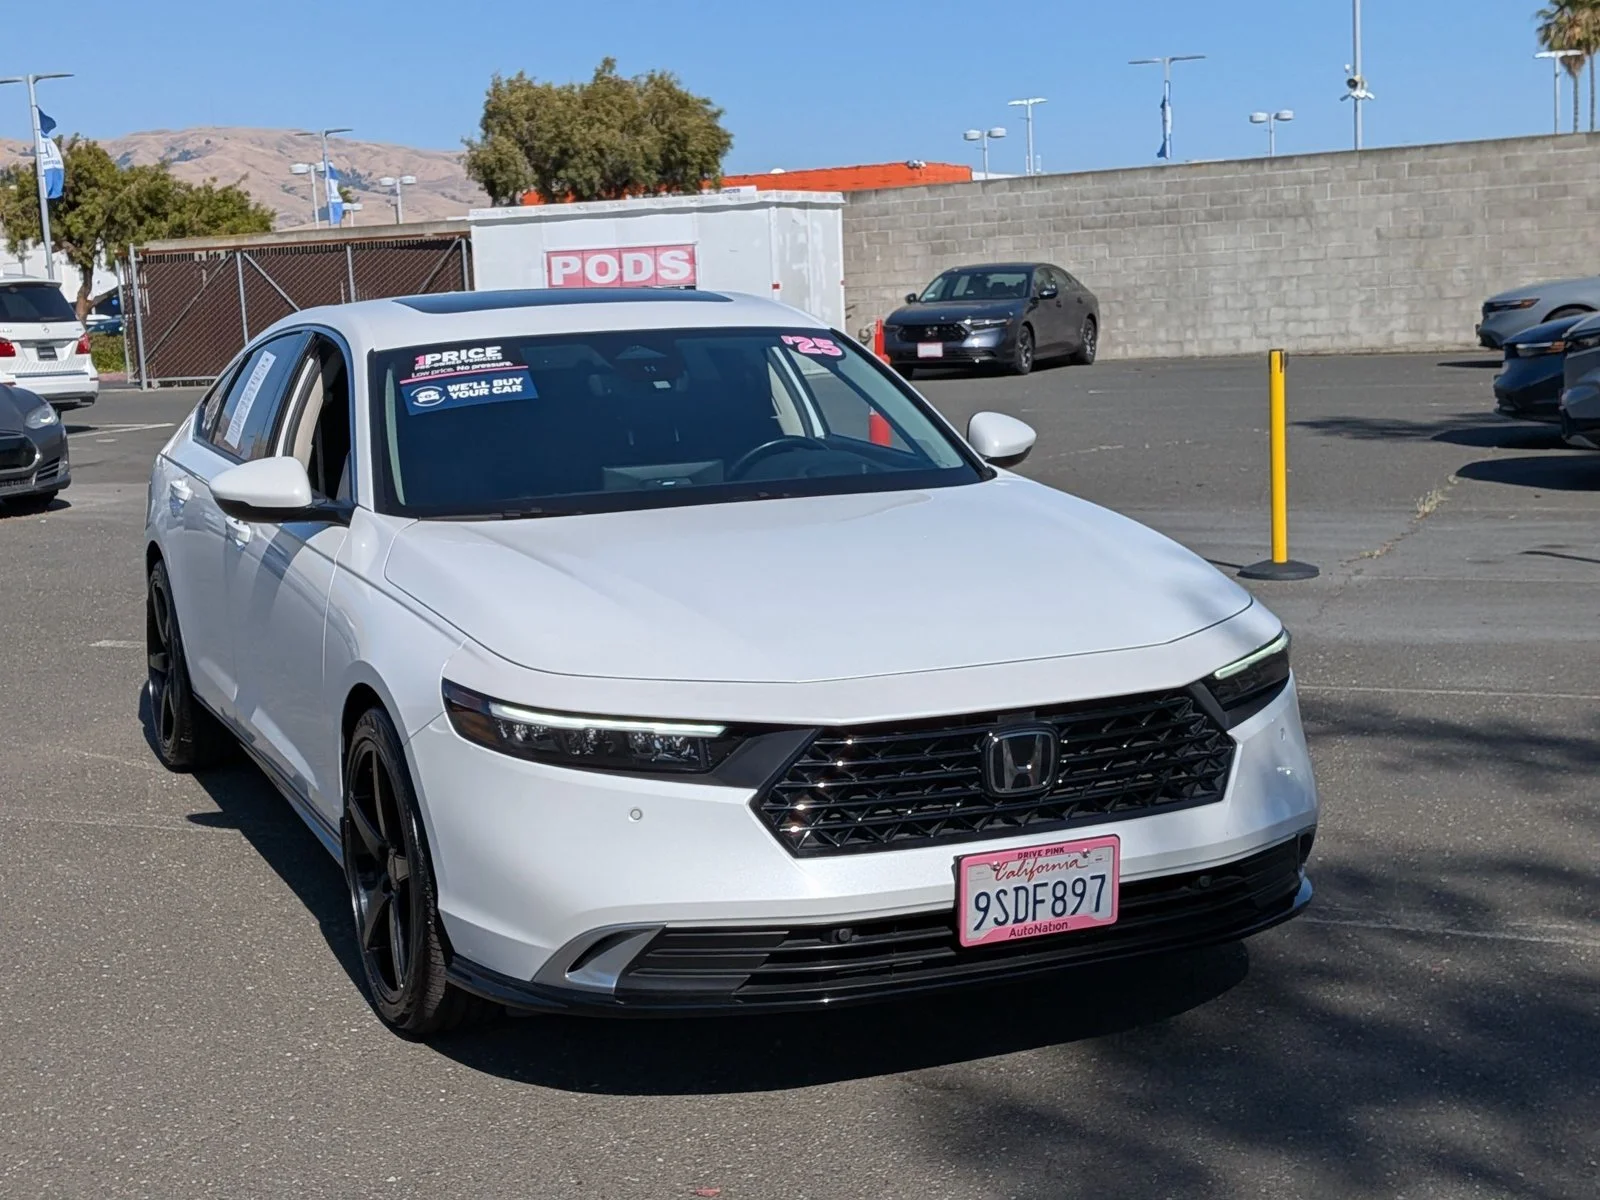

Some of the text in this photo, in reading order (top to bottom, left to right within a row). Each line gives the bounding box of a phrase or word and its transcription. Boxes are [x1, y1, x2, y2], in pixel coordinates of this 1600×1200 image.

[551, 250, 691, 285] PODS
[447, 377, 524, 392] WE'LL BUY
[449, 385, 523, 400] YOUR CAR
[1017, 846, 1065, 860] DRIVE PINK
[994, 857, 1089, 883] California
[973, 874, 1106, 931] 9SDF897
[1008, 921, 1068, 938] AutoNation
